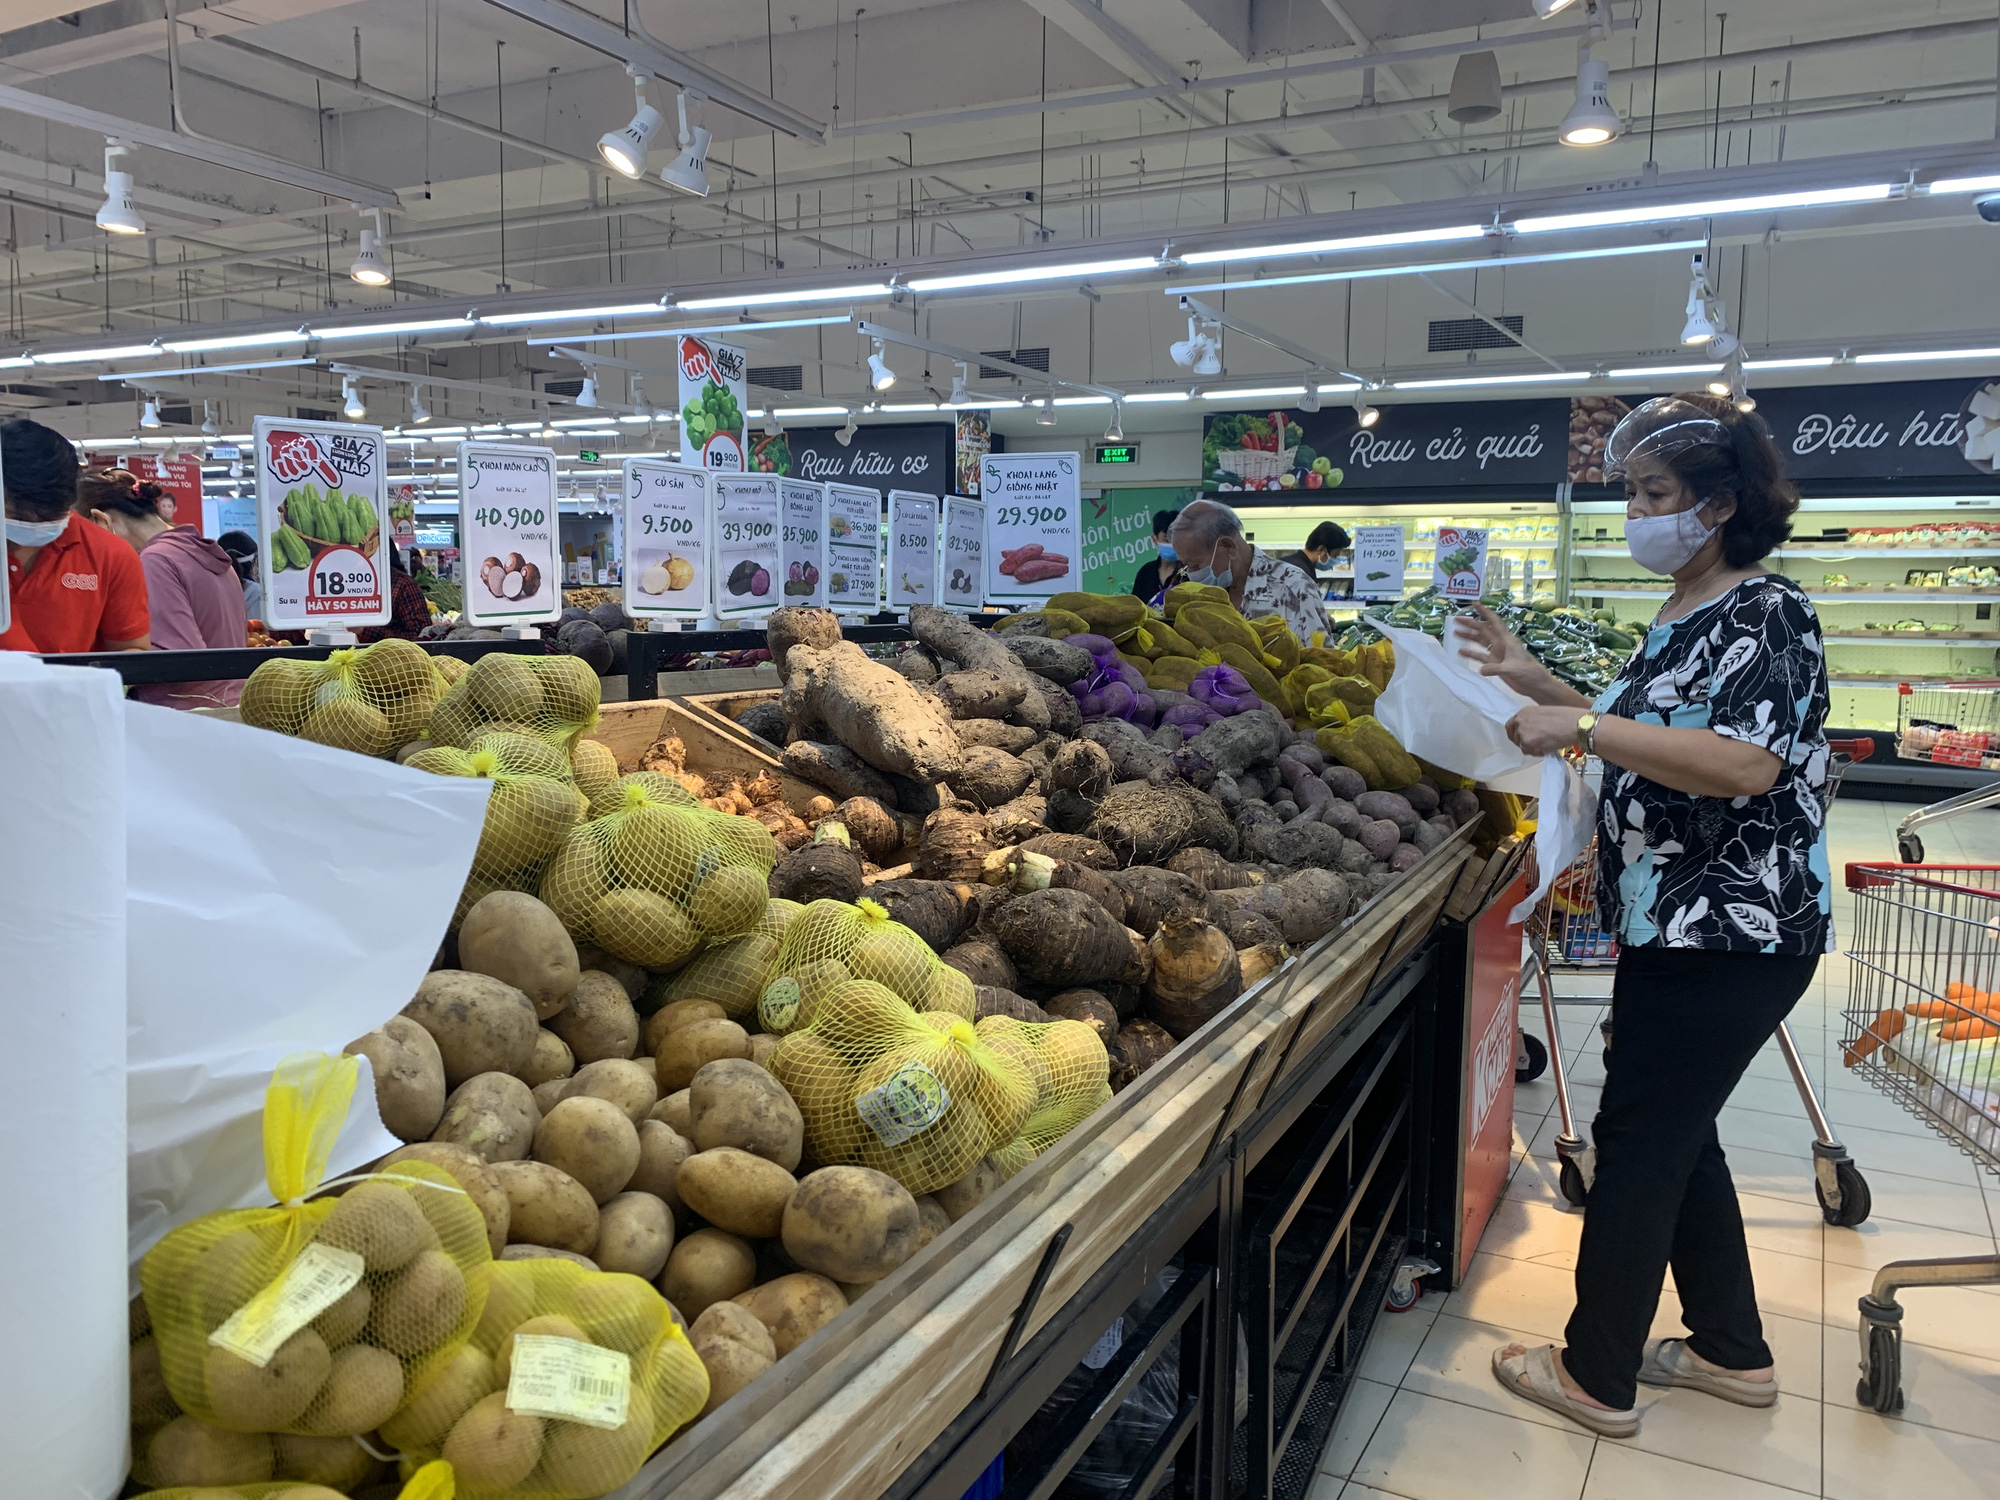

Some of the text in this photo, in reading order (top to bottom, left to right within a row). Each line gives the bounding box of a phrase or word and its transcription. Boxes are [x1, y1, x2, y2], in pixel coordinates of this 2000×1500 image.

[1792, 410, 1965, 455] Đậu hũ
[1104, 448, 1127, 456] EXIT
[1350, 424, 1545, 471] Rau củ quả
[480, 461, 502, 470] KHOAI
[523, 464, 539, 472] CAO
[801, 449, 929, 480] Rau hữu cơ
[173, 472, 185, 480] VUI
[655, 476, 667, 487] CỦ
[1006, 470, 1058, 480] KHOAI LANG
[1006, 480, 1059, 492] GIỐNG NHẬT
[475, 507, 545, 530] 40.900
[997, 506, 1067, 526] 29.900
[642, 514, 693, 535] 9.500
[851, 521, 877, 533] 36.900
[1081, 504, 1152, 548] uôn tươi
[521, 532, 548, 541] VND/KG
[722, 522, 772, 541] 39.900
[783, 525, 818, 544] 35.900
[677, 539, 701, 548] VND/KG
[756, 541, 776, 549] VND/KG
[900, 533, 928, 548] 8.500
[948, 535, 981, 553] 32.900
[1081, 535, 1156, 573] uôn ngon
[1363, 549, 1396, 558] 14.900
[851, 579, 875, 591] 27.900
[307, 598, 379, 611] HÃY SO SÁNH
